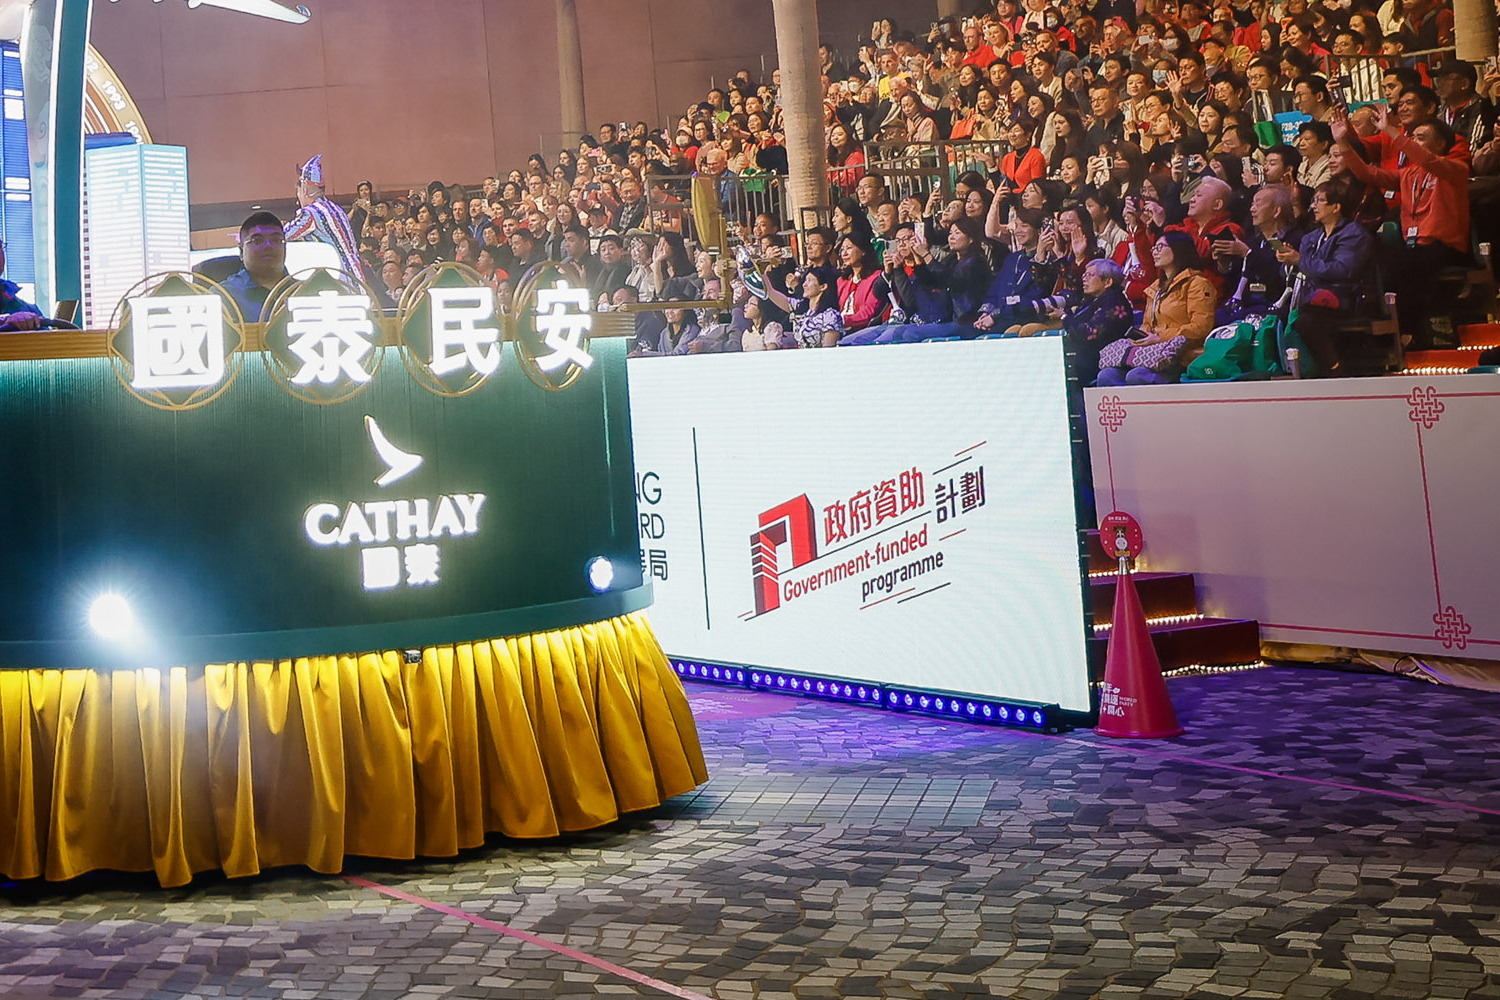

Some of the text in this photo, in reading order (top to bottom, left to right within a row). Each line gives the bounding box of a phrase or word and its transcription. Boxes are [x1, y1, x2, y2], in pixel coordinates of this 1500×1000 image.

[102, 80, 127, 111] 1993
[129, 279, 595, 390] 國泰民安
[304, 493, 487, 546] CATHAY
[824, 465, 986, 546] 政府資助 計劃
[783, 522, 928, 602] Government-funded
[861, 551, 944, 602] programme
